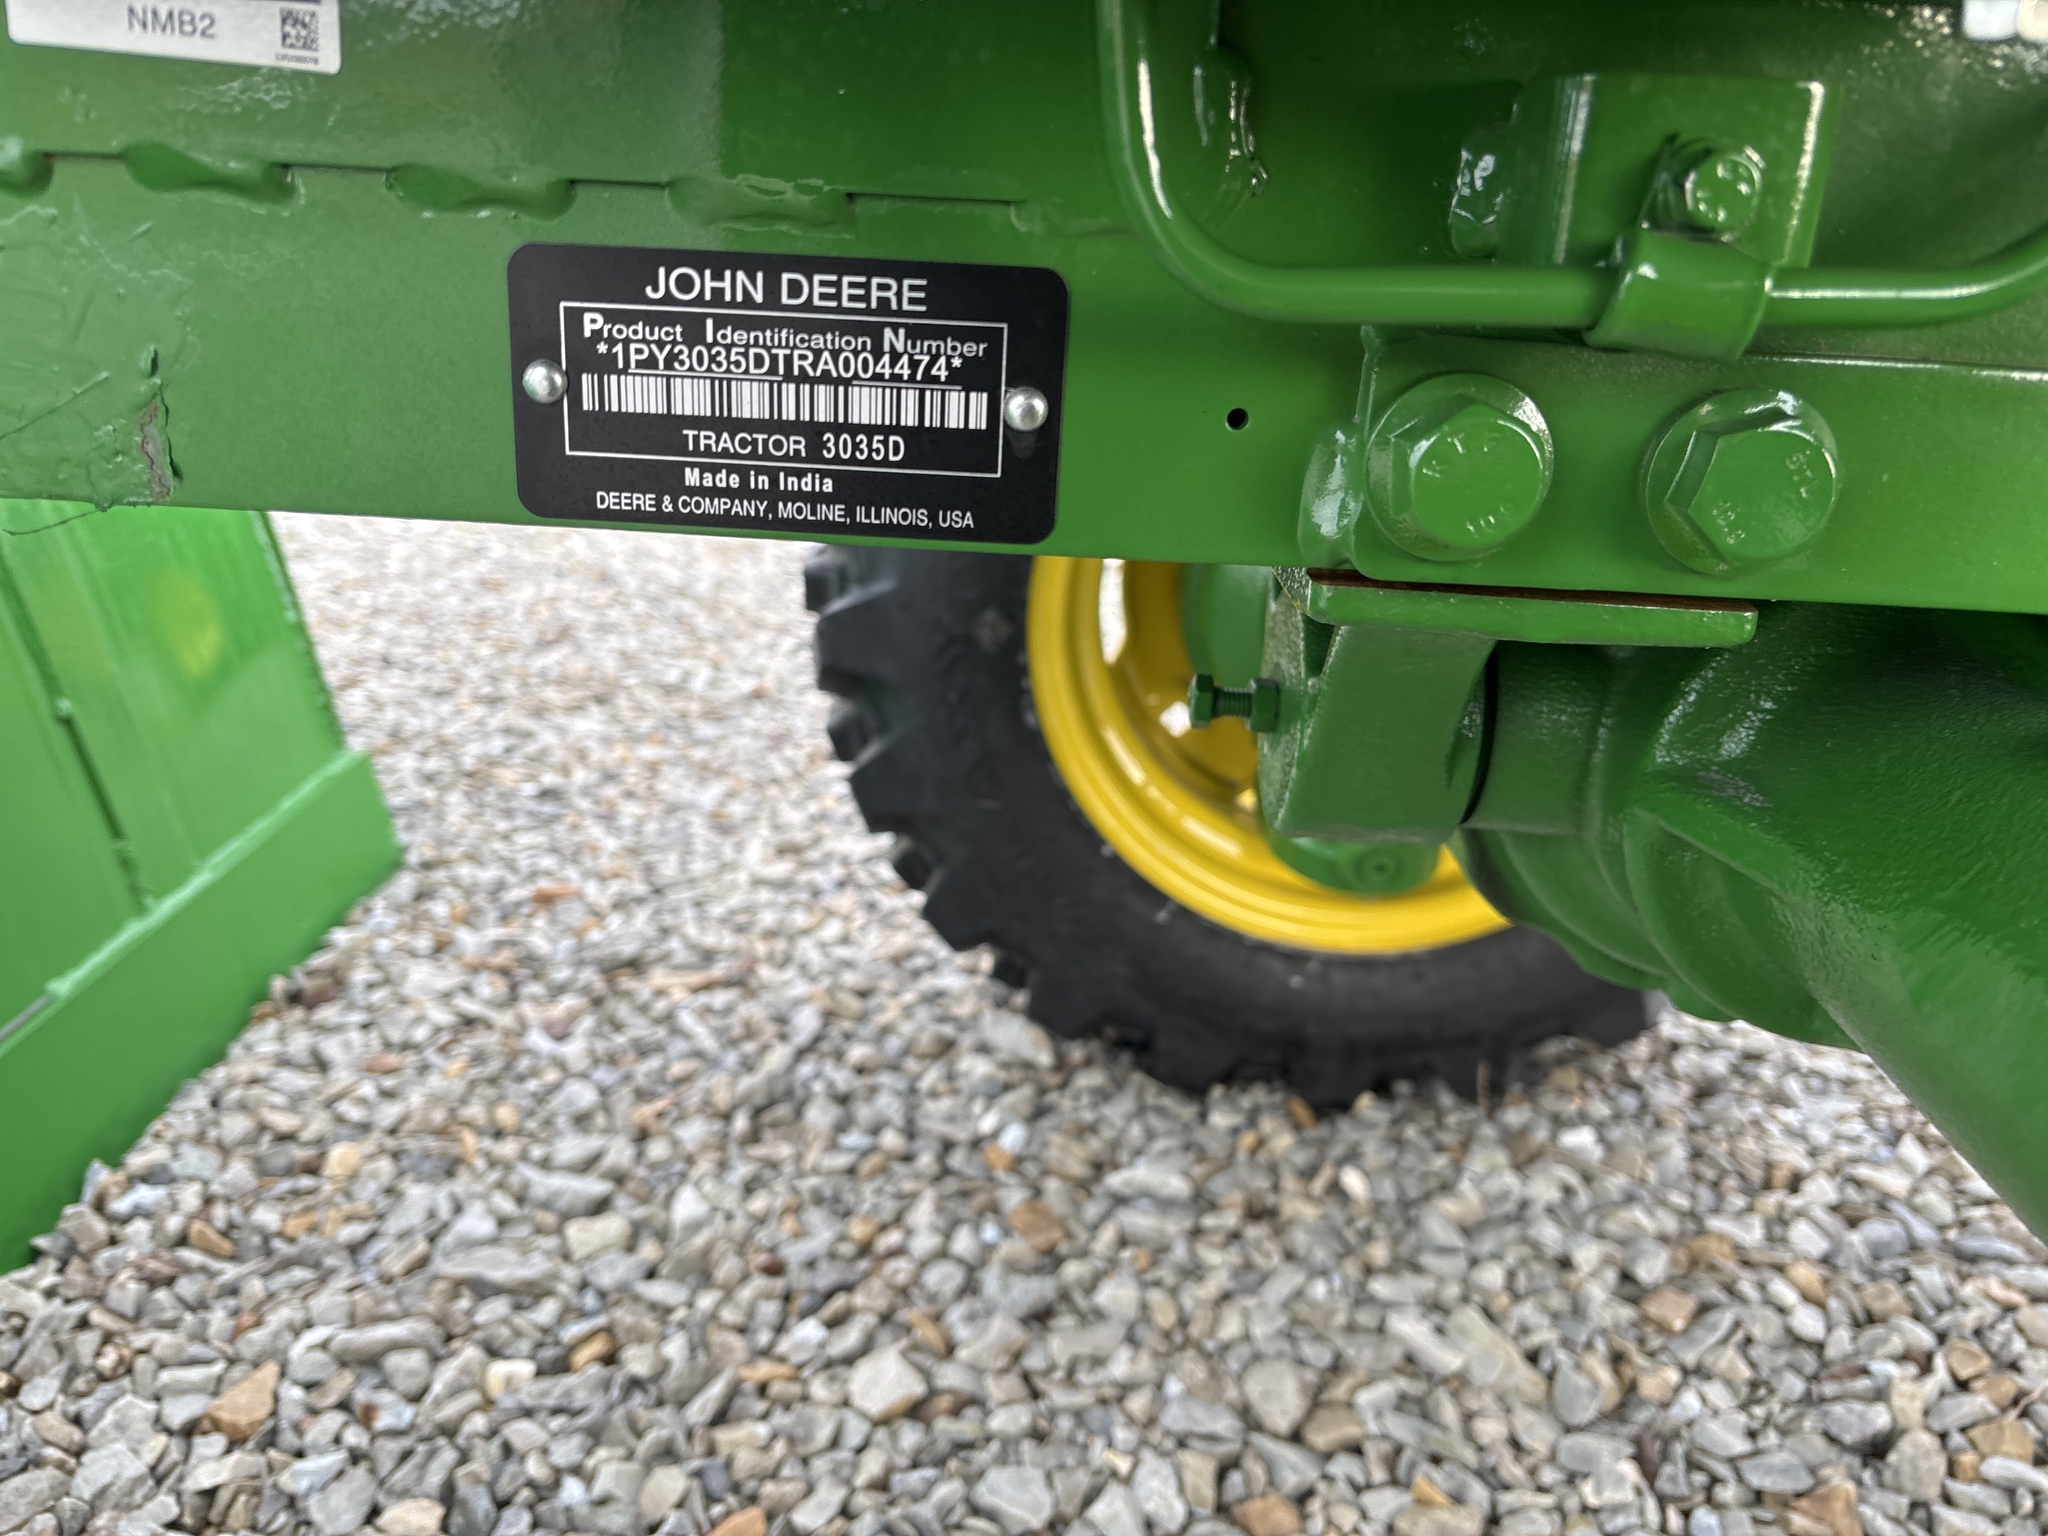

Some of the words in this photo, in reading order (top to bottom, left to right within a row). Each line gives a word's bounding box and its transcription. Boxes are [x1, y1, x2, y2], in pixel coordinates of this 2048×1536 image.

[127, 5, 216, 38] NMB2
[645, 266, 763, 303] JOHN
[781, 272, 927, 311] DEERE
[583, 312, 683, 342] Product
[706, 317, 871, 351] Identification
[883, 327, 987, 357] Number
[682, 429, 806, 457] TRACTOR
[822, 432, 905, 461] 3035D
[684, 467, 740, 488] Made
[750, 470, 769, 490] in
[779, 471, 833, 492] India
[596, 491, 656, 511] DEERE
[662, 495, 673, 512] &
[678, 495, 772, 520] COMPANY,
[778, 501, 850, 524] MOLINE,
[856, 506, 932, 529] ILLINOIS,
[939, 510, 974, 528] USA
